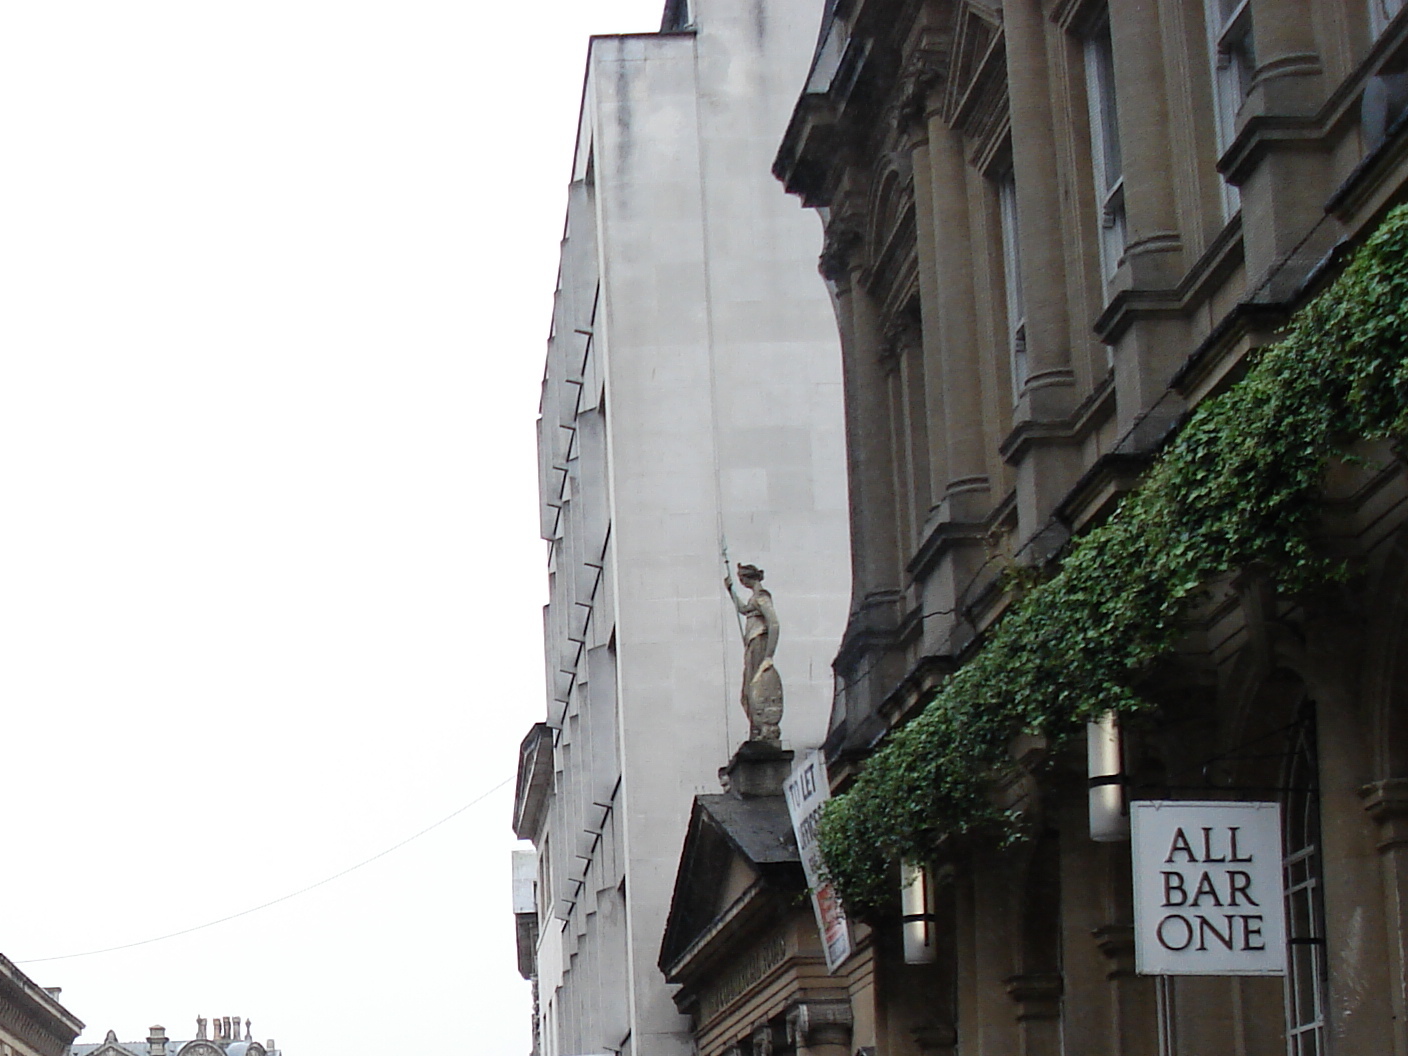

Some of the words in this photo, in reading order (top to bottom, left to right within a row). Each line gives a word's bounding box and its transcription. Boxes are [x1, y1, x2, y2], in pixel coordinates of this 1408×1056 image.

[799, 763, 817, 801] LET
[1164, 827, 1252, 863] ALL
[1159, 870, 1260, 907] BAR
[1156, 914, 1265, 951] ONE
